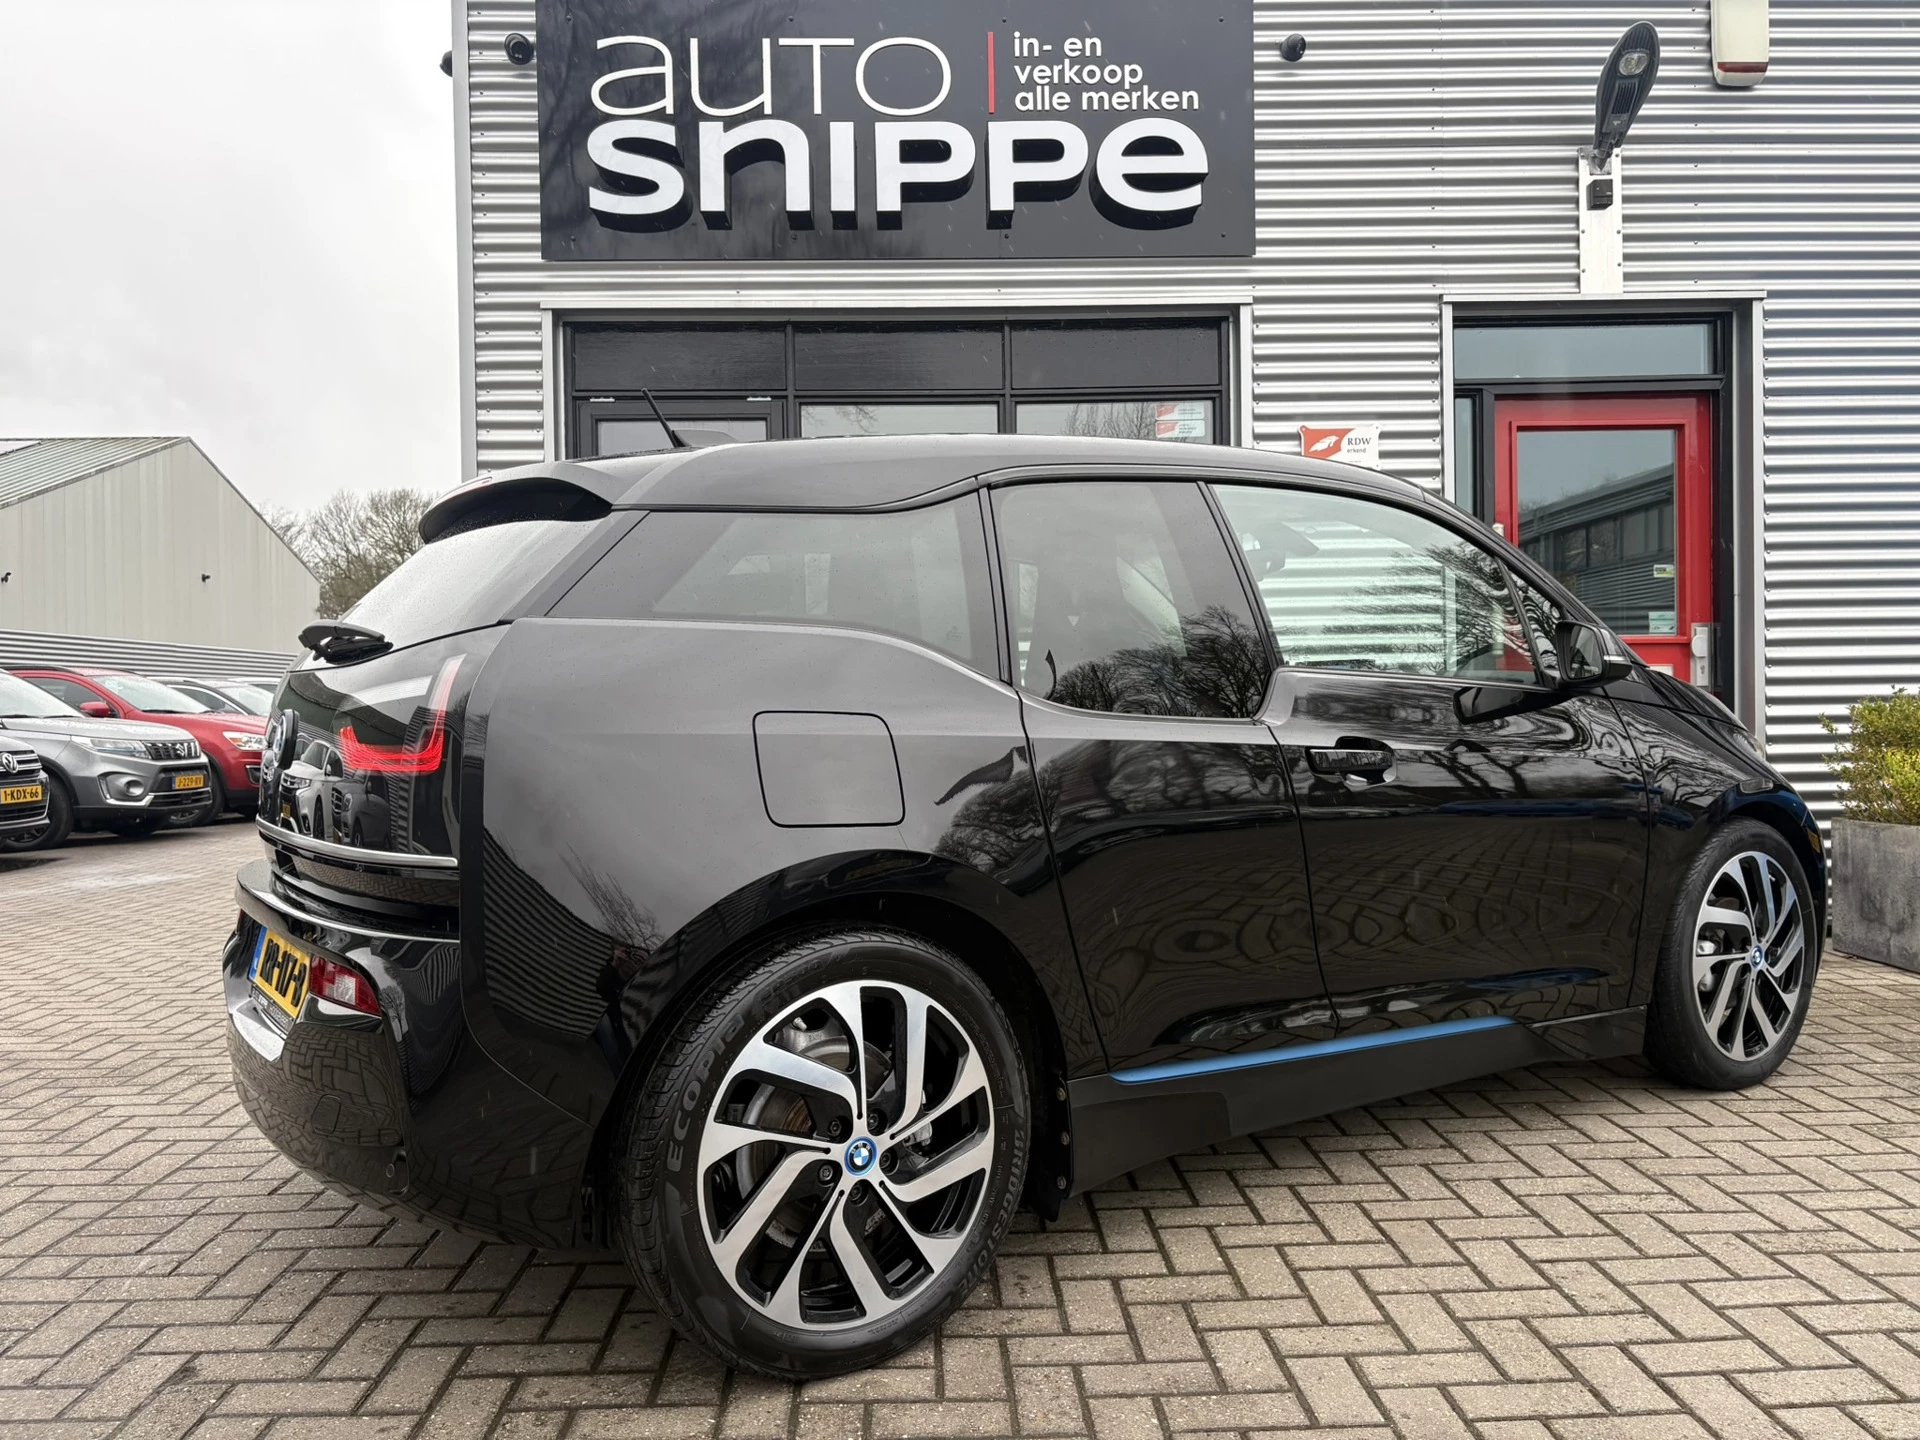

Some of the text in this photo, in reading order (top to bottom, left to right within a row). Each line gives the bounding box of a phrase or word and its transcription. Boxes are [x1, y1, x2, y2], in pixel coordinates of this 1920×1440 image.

[1013, 31, 1102, 57] in- en
[1014, 59, 1143, 89] verkoop
[1014, 85, 1199, 111] alle merken
[1347, 437, 1372, 446] RDW
[3, 787, 40, 801] 1-KDX-66
[666, 1012, 745, 1172] ECOPIA
[957, 1129, 1026, 1296] BRIDGESTONE
